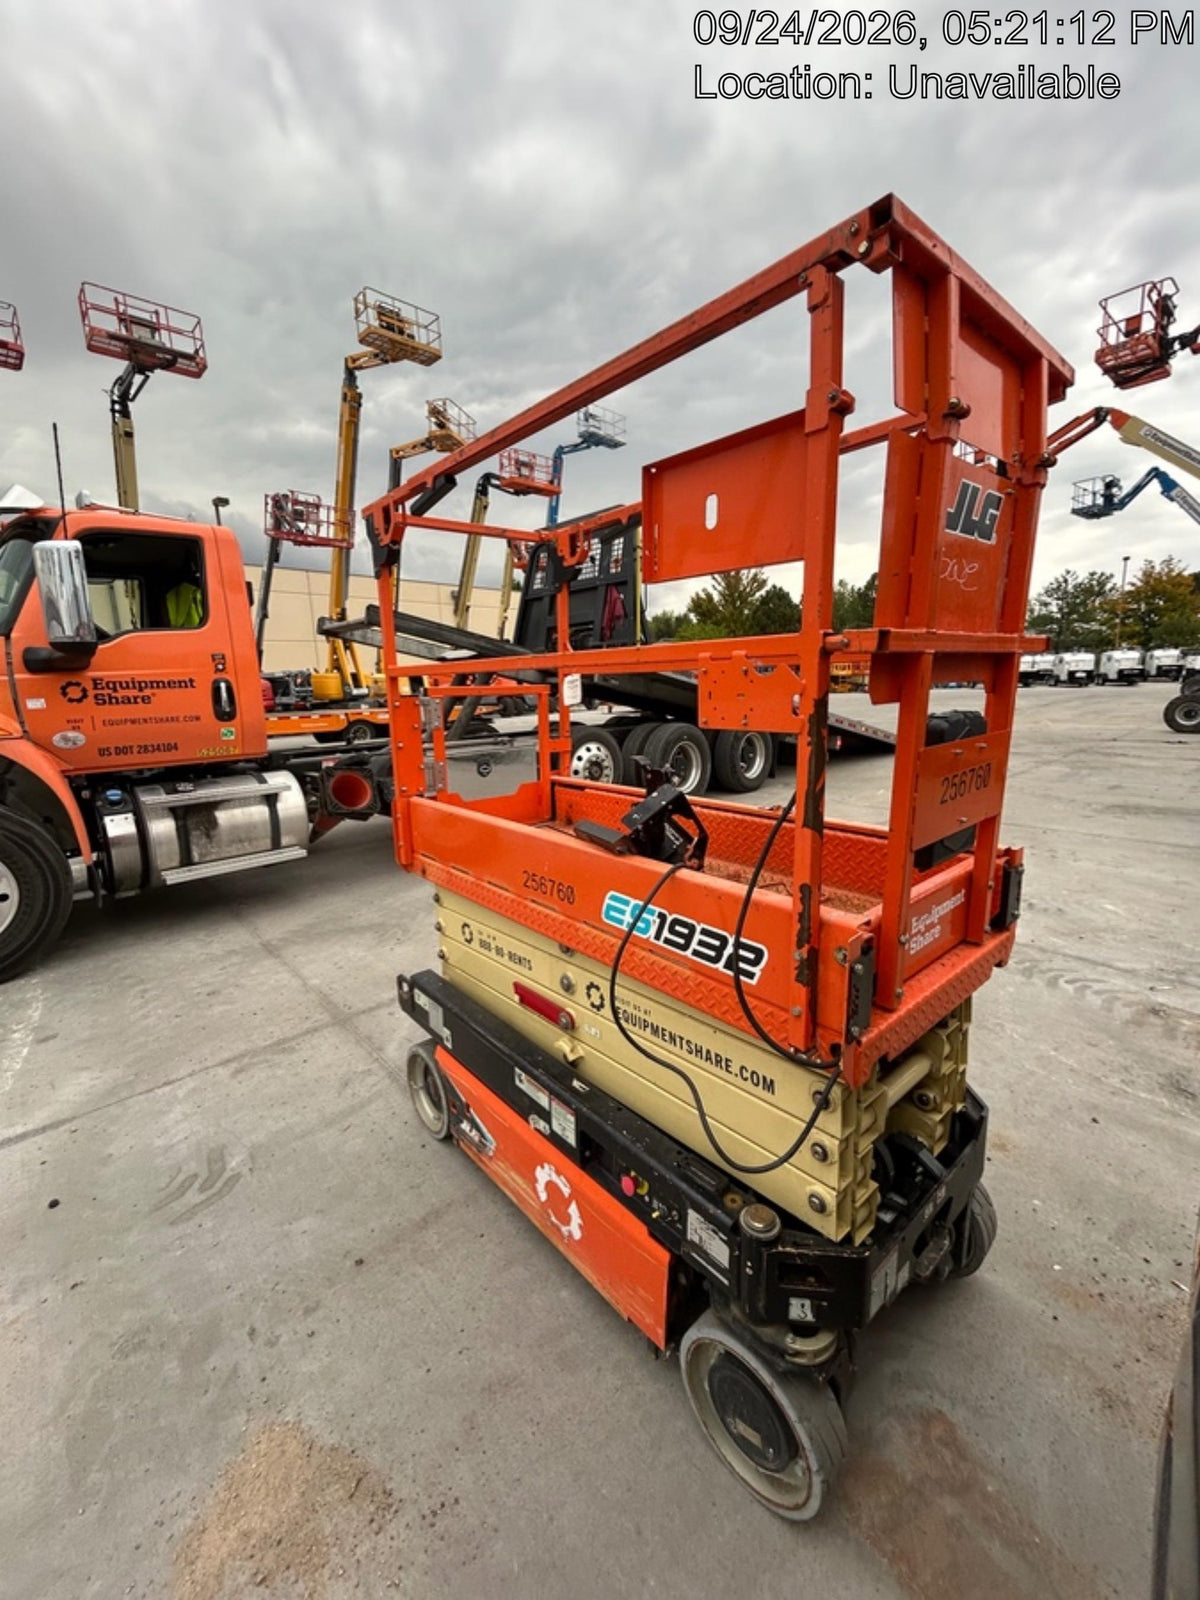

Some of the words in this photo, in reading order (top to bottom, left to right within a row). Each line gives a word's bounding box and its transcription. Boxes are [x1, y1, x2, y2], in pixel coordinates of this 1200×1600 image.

[945, 478, 1004, 544] JLG
[91, 676, 196, 692] Equipment
[93, 692, 152, 706] Share
[102, 715, 201, 727] EQUIPMENTSHARE.COM
[97, 747, 112, 757] US
[114, 746, 134, 756] DOT
[136, 742, 178, 755] 2834104
[940, 762, 992, 805] 256760
[521, 869, 577, 906] 256760
[911, 888, 966, 935] Equipment
[602, 891, 768, 985] ES1932
[909, 924, 942, 954] Share
[615, 1004, 776, 1096] EQUIPMENTSHARE.COM
